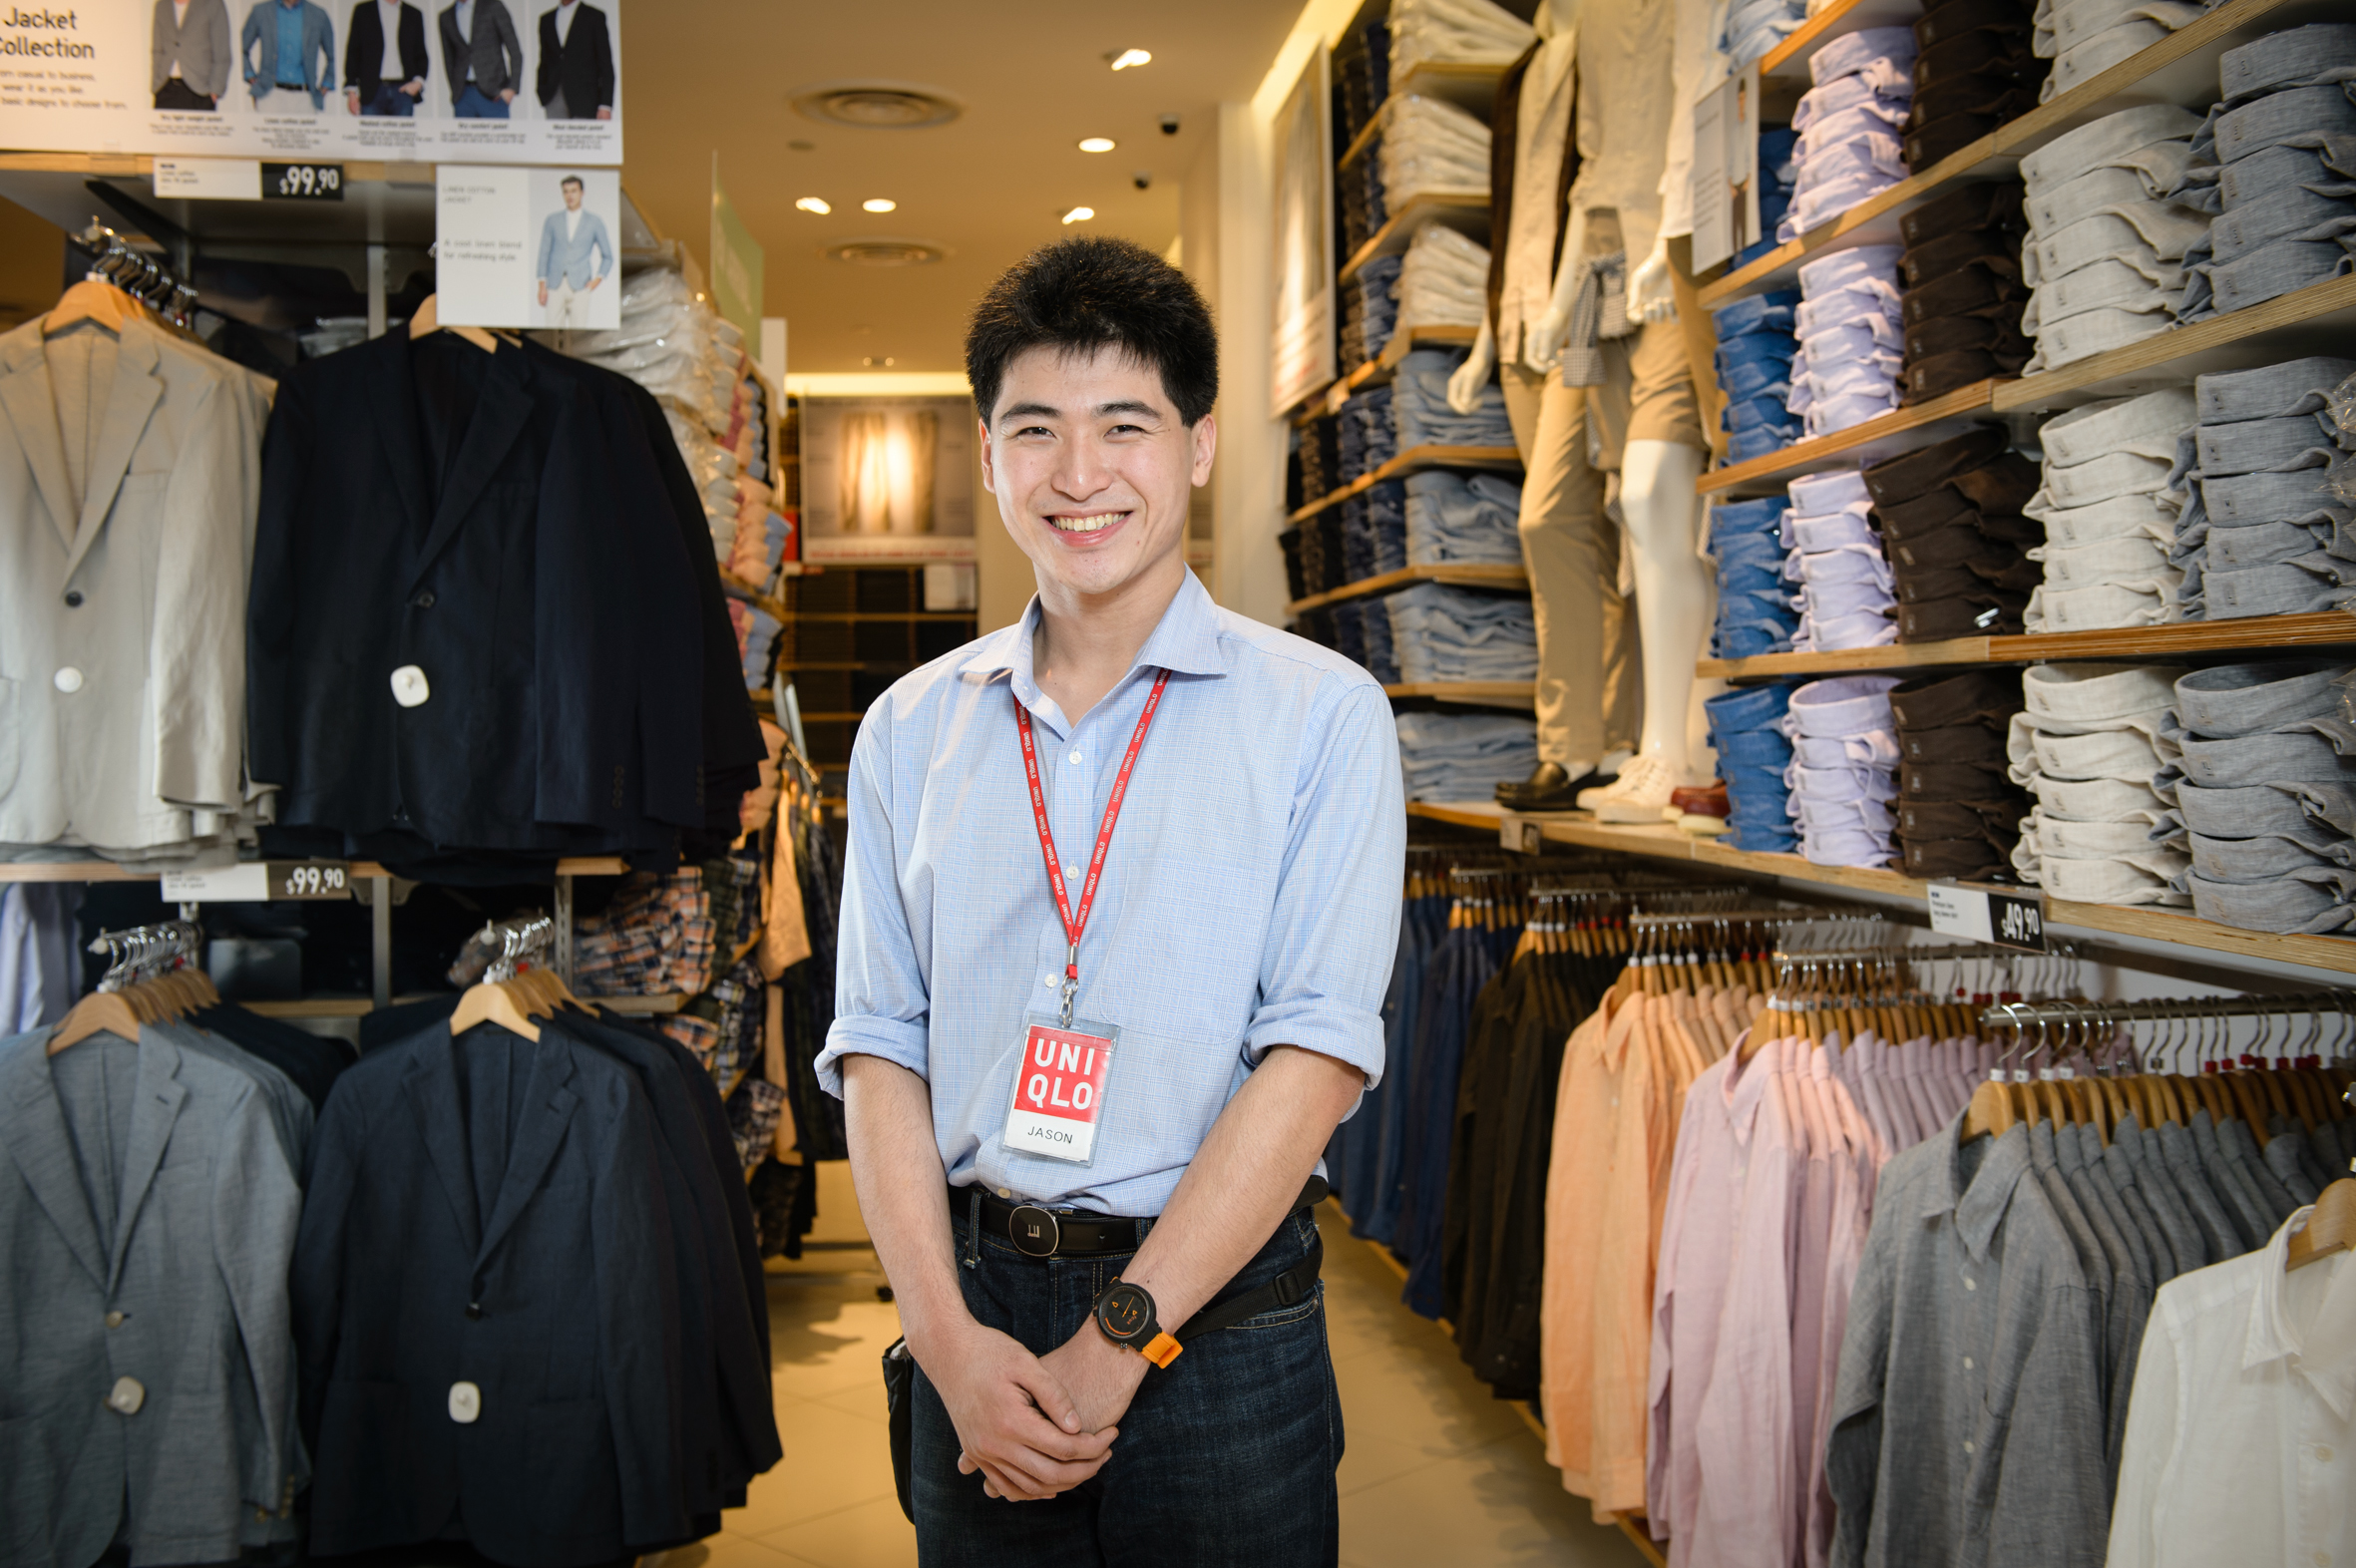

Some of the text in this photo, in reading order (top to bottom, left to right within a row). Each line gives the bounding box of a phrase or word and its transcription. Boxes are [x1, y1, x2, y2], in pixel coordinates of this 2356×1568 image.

[3, 6, 77, 30] Jacket
[0, 35, 95, 59] ollection
[47, 71, 57, 80] to
[60, 99, 70, 108] to
[279, 166, 340, 196] $99.90
[1145, 693, 1158, 714] UNIQLO
[1023, 731, 1032, 752] UNIQLO
[1133, 722, 1146, 743] UNIQLO
[1027, 758, 1037, 779] UNIQLO
[1123, 750, 1135, 772] UNIQLO
[1113, 780, 1124, 802] UNIQLO
[1038, 814, 1047, 836] UNIQLO
[1103, 810, 1115, 833] UNIQLO
[1045, 843, 1055, 866] UNIQLO
[1094, 842, 1105, 865] UNIQLO
[285, 867, 345, 896] $99.90
[1053, 874, 1063, 896] UNIQLO
[1085, 873, 1097, 896] UNIQLO
[1061, 904, 1071, 926] UNIQLO
[1077, 904, 1088, 928] UNIQLO
[2001, 902, 2040, 942] $49.90
[1034, 1037, 1095, 1075] UNI
[1027, 1073, 1093, 1110] QLO
[1027, 1126, 1073, 1144] JASON
